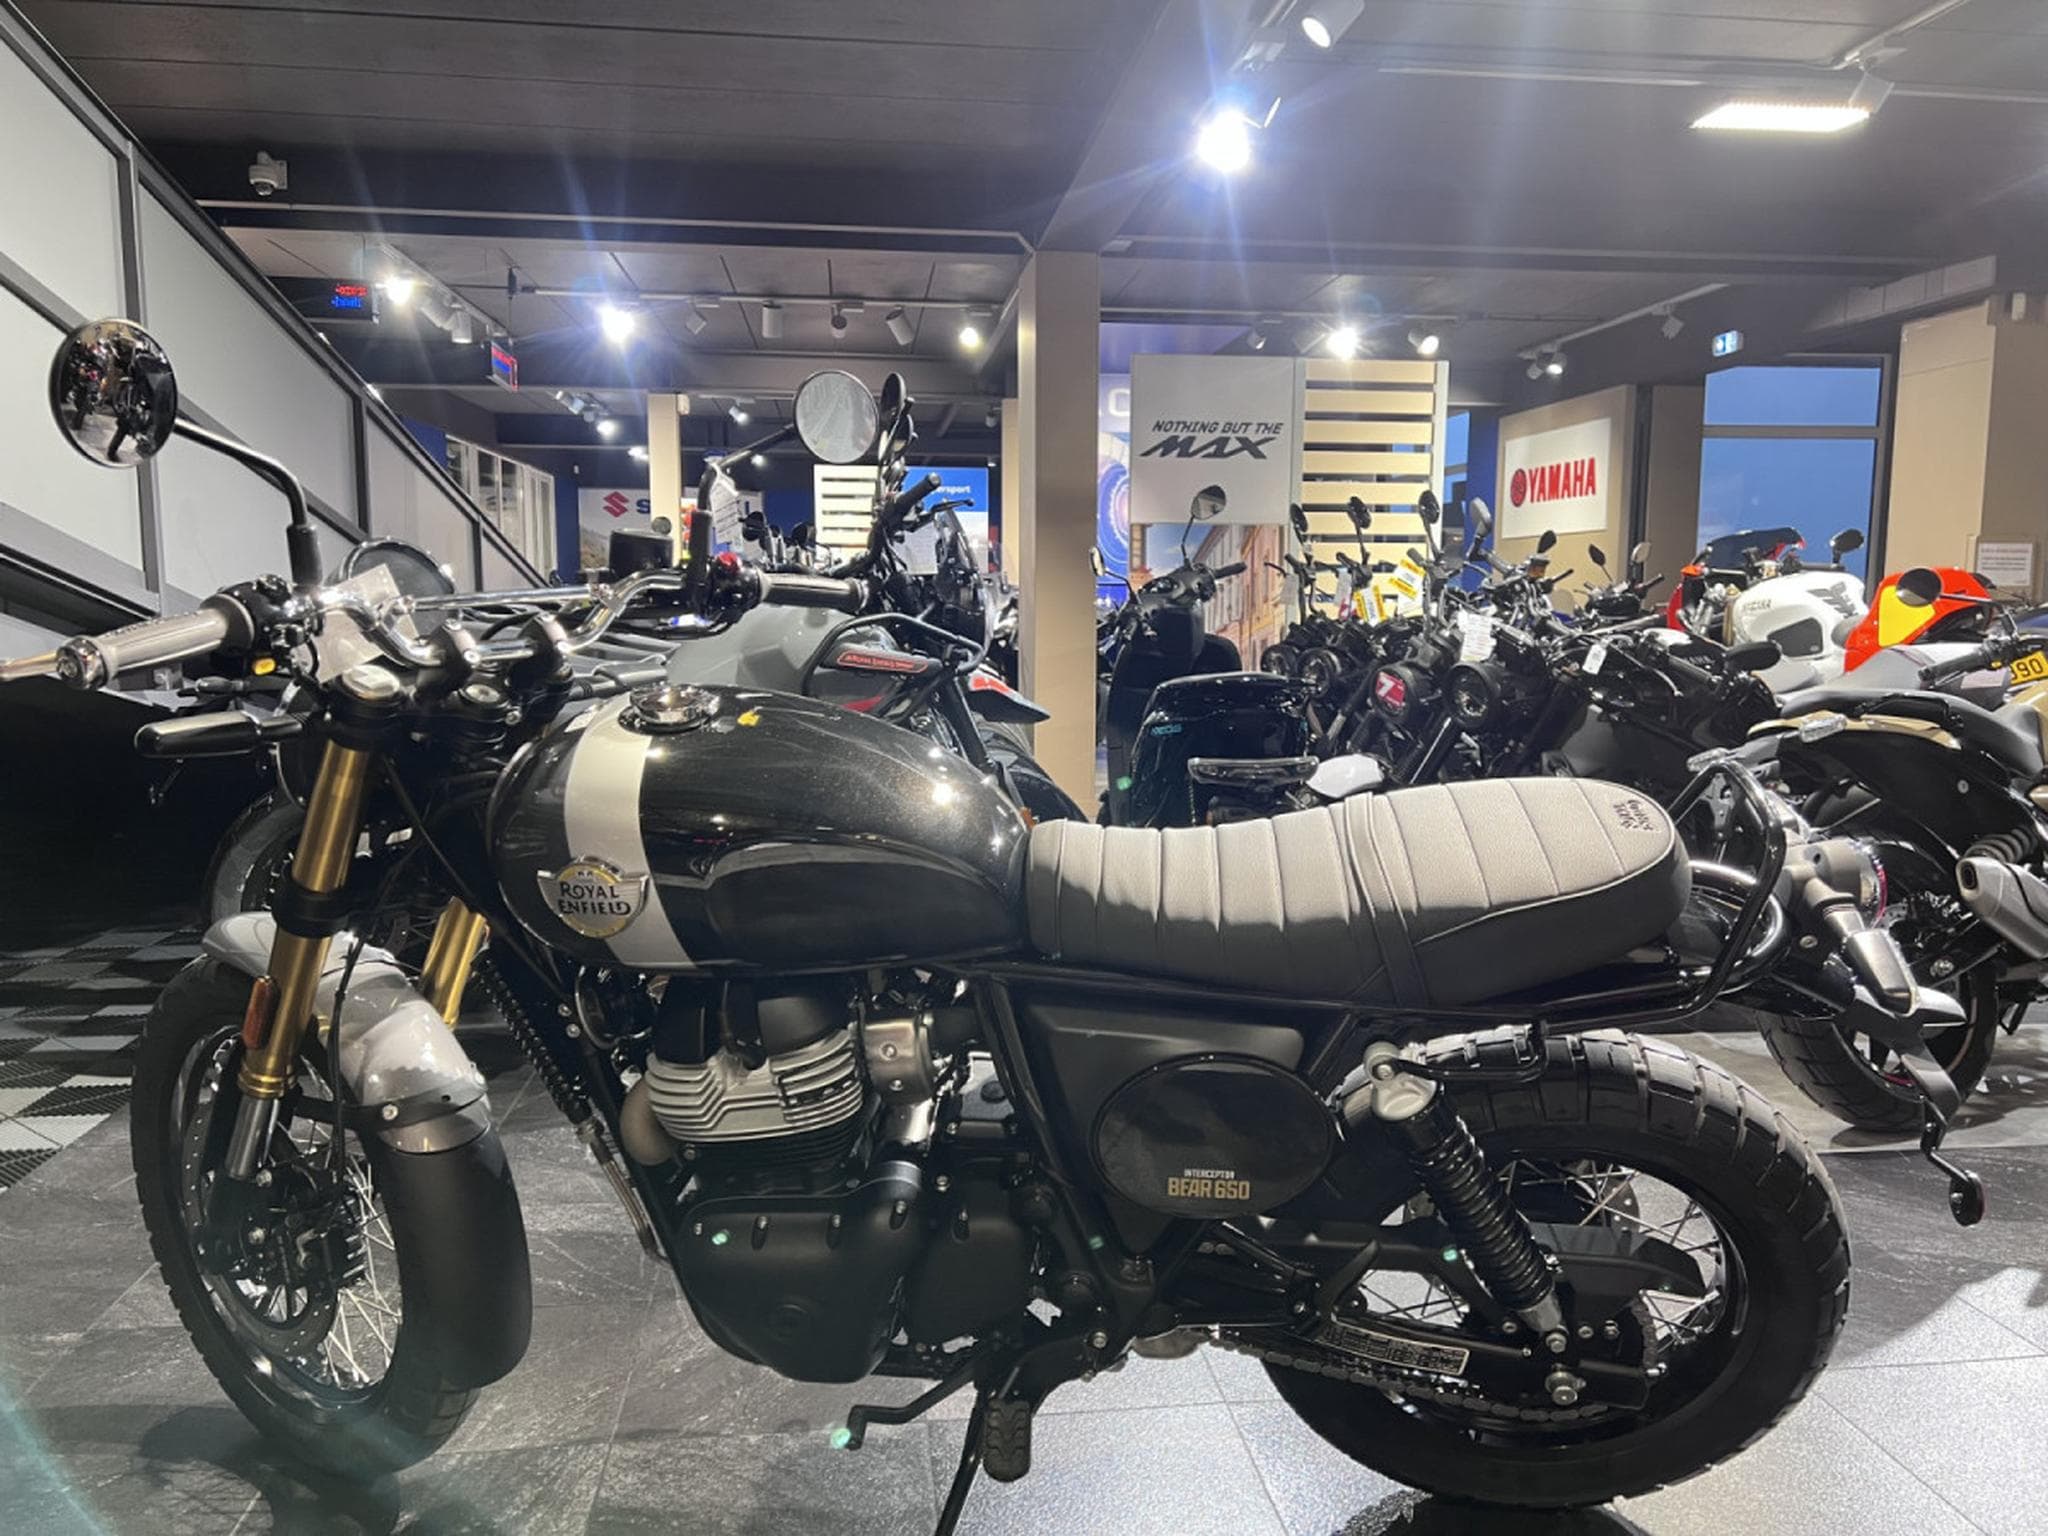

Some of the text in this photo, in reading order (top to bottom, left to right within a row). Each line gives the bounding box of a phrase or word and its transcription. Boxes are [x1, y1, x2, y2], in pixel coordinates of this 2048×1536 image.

[1152, 420, 1285, 435] NOTHING BUT THE
[1139, 435, 1277, 460] MAX
[1528, 457, 1596, 504] YAMAHA
[560, 881, 620, 899] ROYAL
[558, 900, 631, 916] ENFIELD
[1167, 1177, 1250, 1200] BEAR 650
